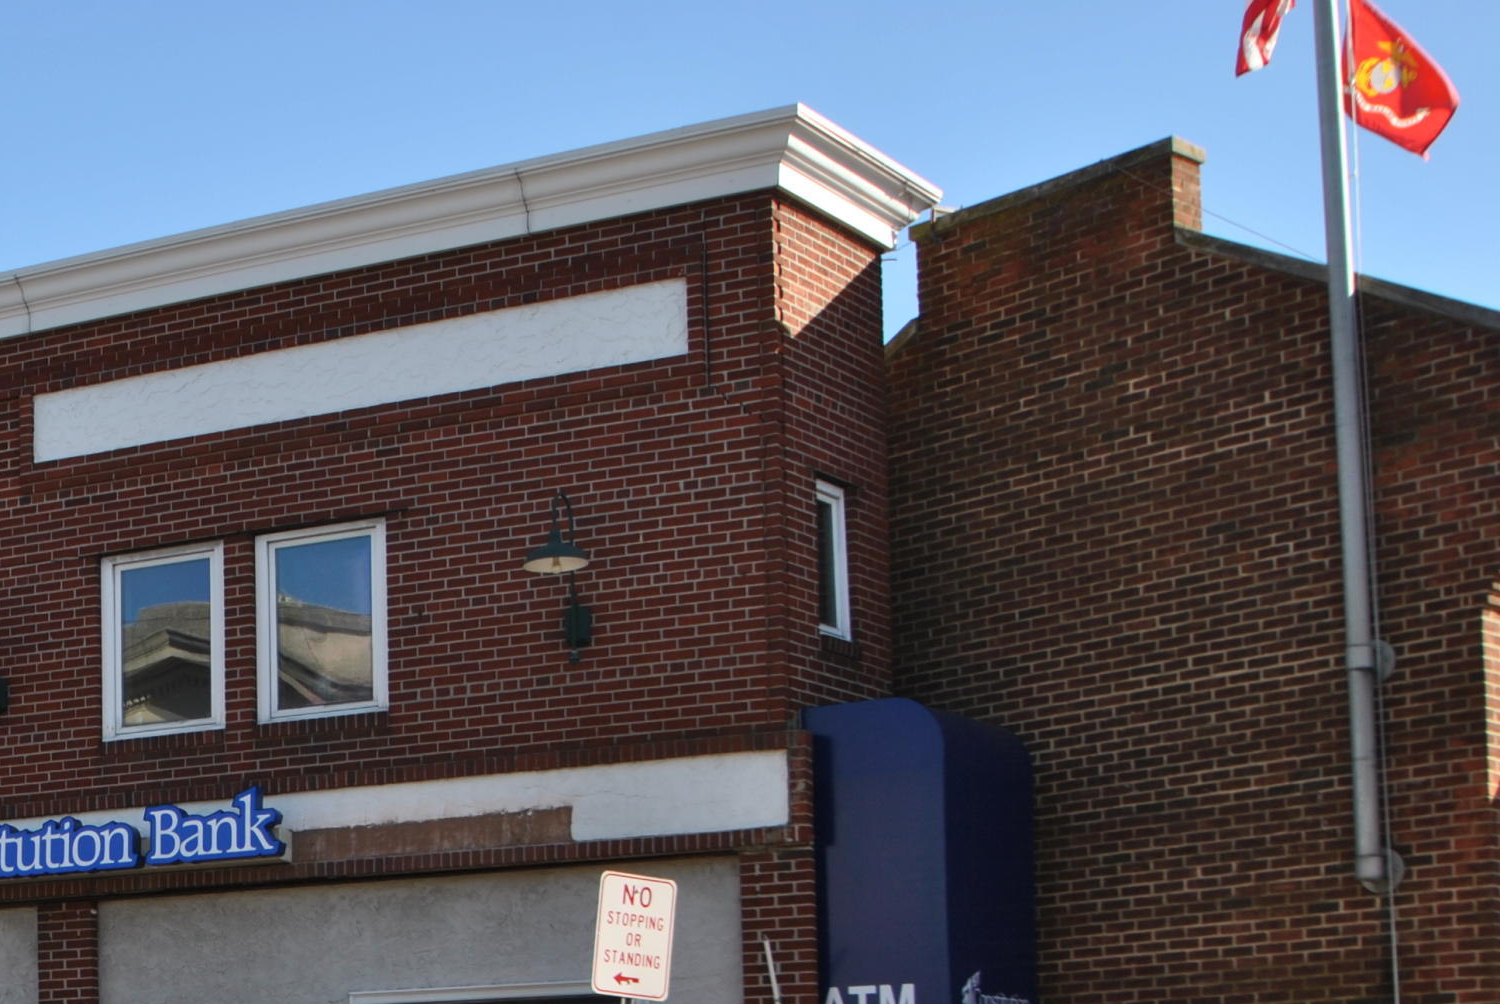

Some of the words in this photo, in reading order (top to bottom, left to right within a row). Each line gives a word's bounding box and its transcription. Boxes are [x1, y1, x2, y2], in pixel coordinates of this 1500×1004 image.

[150, 793, 275, 861] Bank
[622, 883, 652, 908] NO
[606, 910, 665, 932] STOPPING
[625, 932, 642, 948] OR
[603, 948, 661, 970] STANDING
